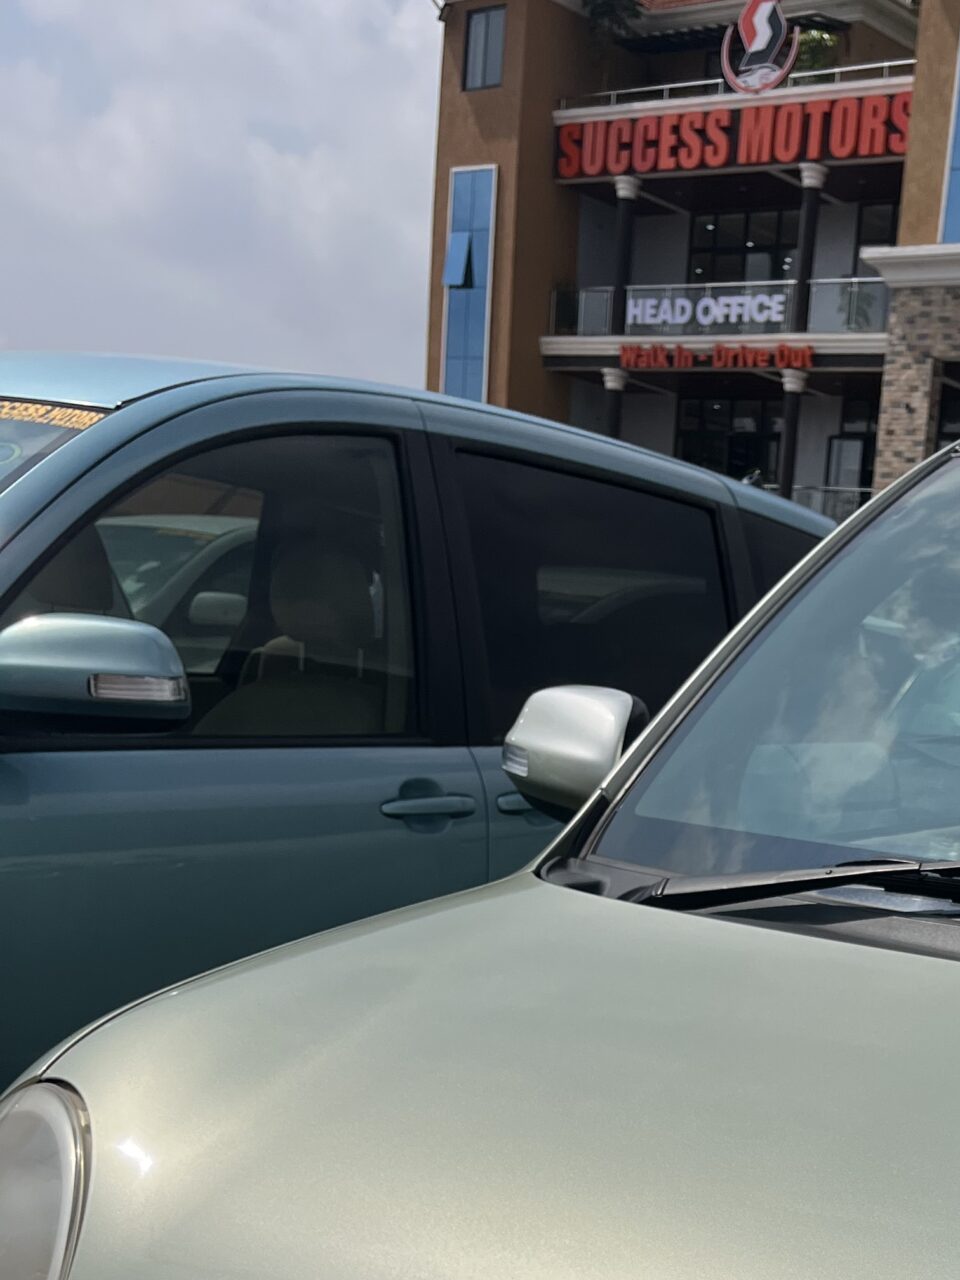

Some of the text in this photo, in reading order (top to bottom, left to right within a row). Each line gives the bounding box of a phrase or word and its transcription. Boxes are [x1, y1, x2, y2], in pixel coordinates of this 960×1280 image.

[559, 92, 912, 177] SUCCESS MOTORS
[626, 294, 786, 326] HEAD OFFICE
[619, 342, 668, 369] Walk
[711, 342, 770, 369] Drive
[774, 342, 814, 369] Out
